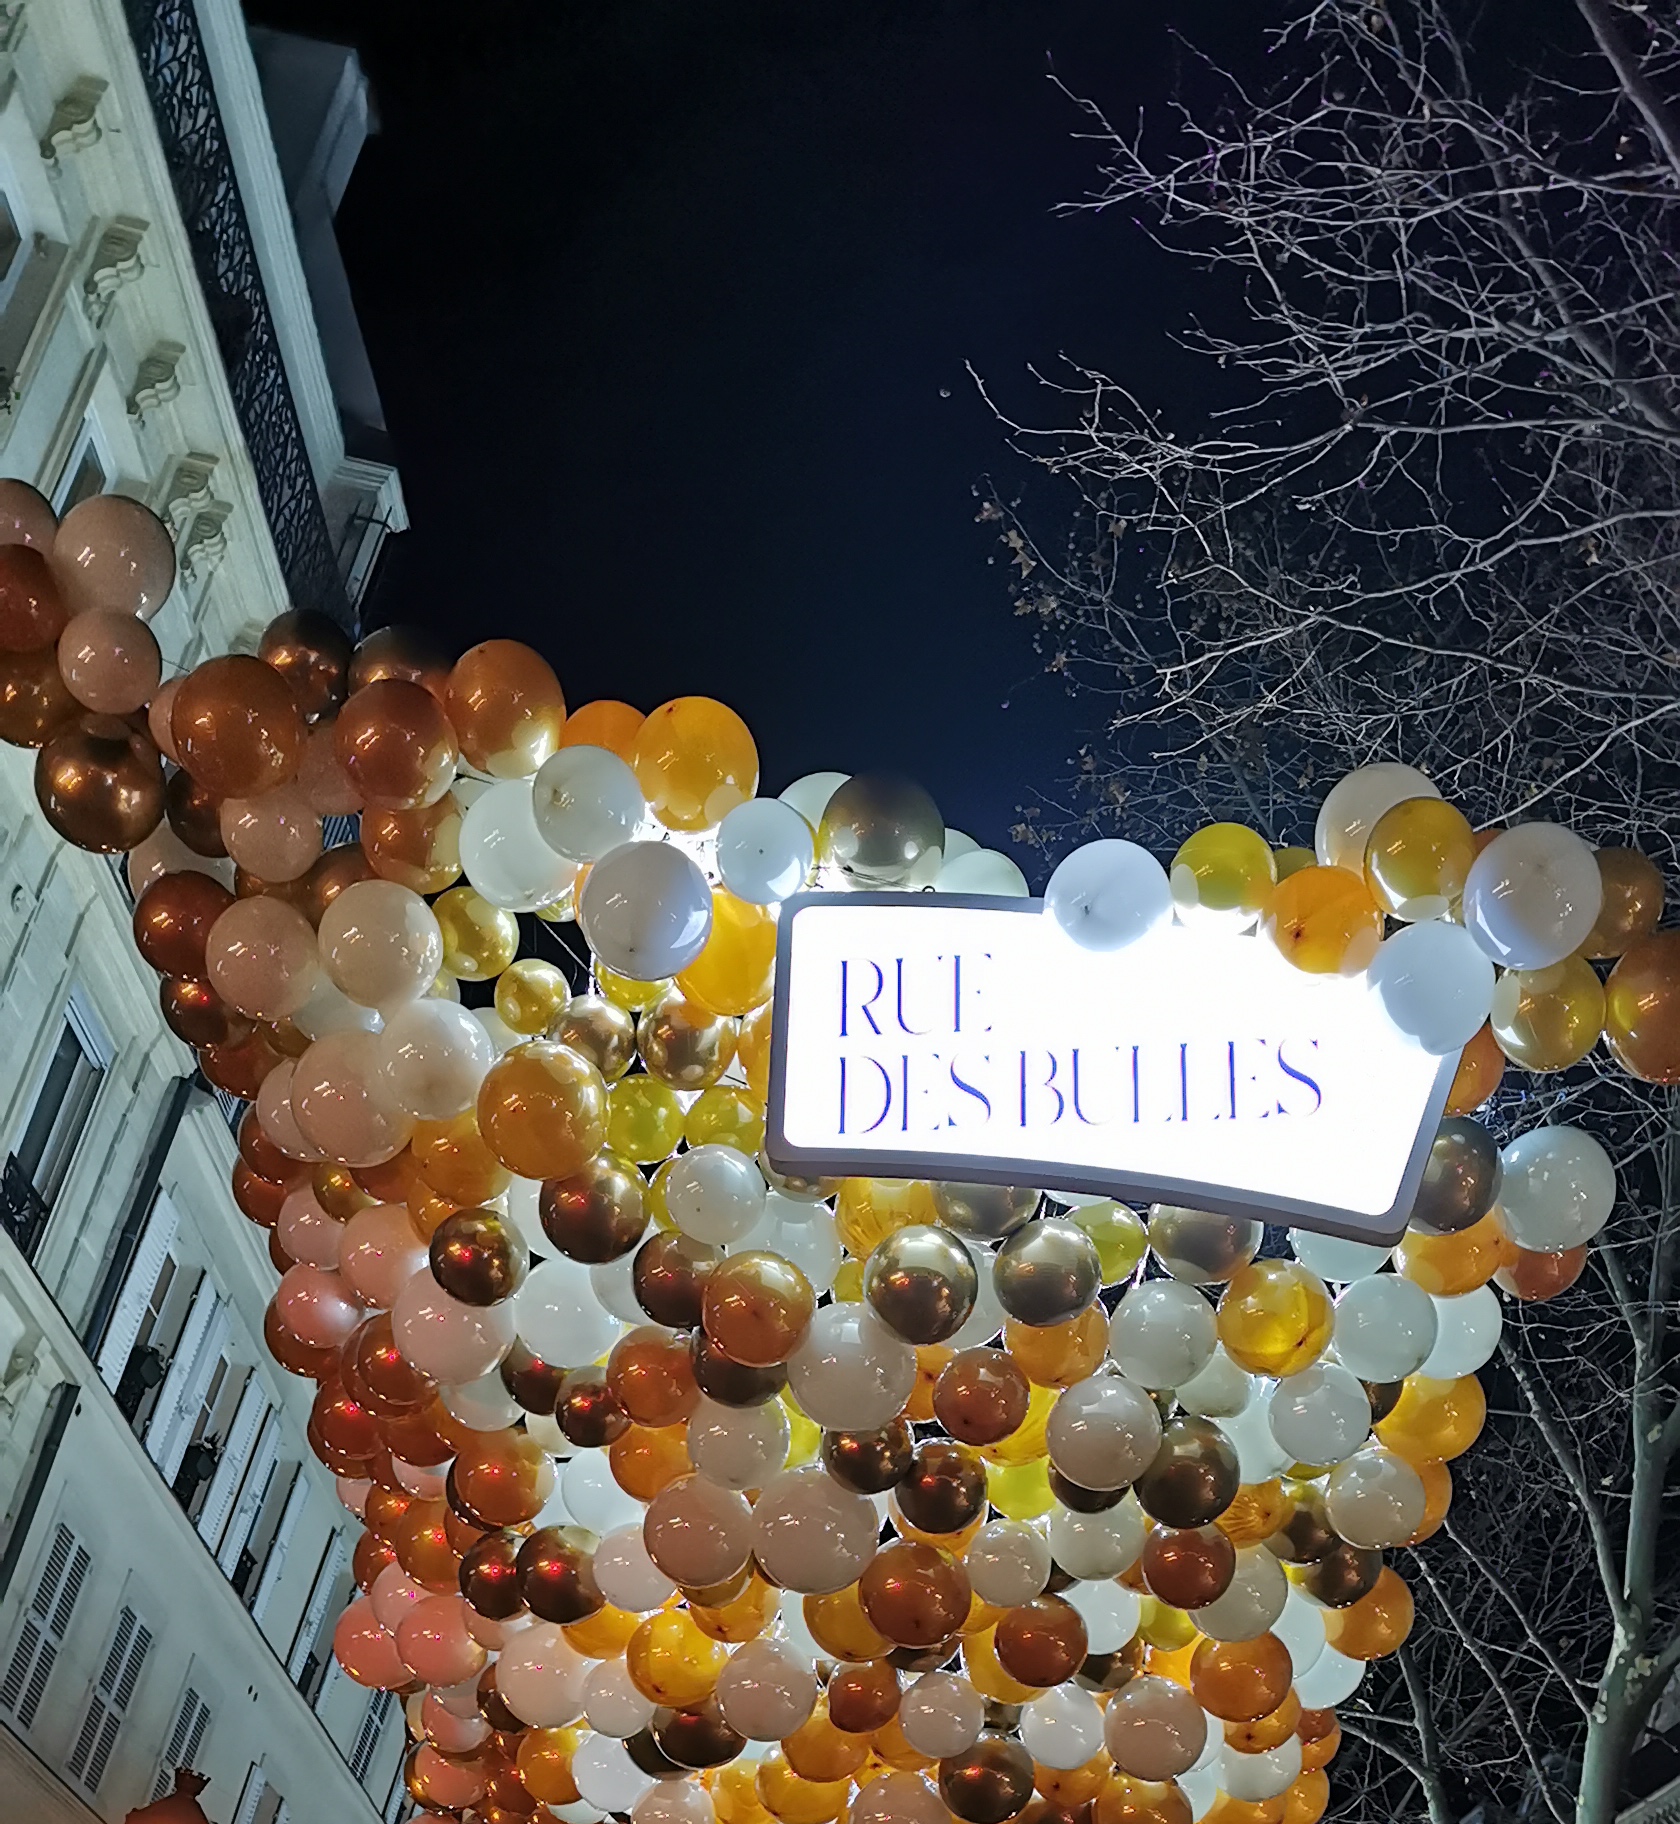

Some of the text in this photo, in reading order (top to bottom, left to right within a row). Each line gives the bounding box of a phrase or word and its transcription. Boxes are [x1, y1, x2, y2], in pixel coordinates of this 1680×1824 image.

[839, 952, 993, 1037] RUE
[838, 1037, 1323, 1134] DES BULLES
